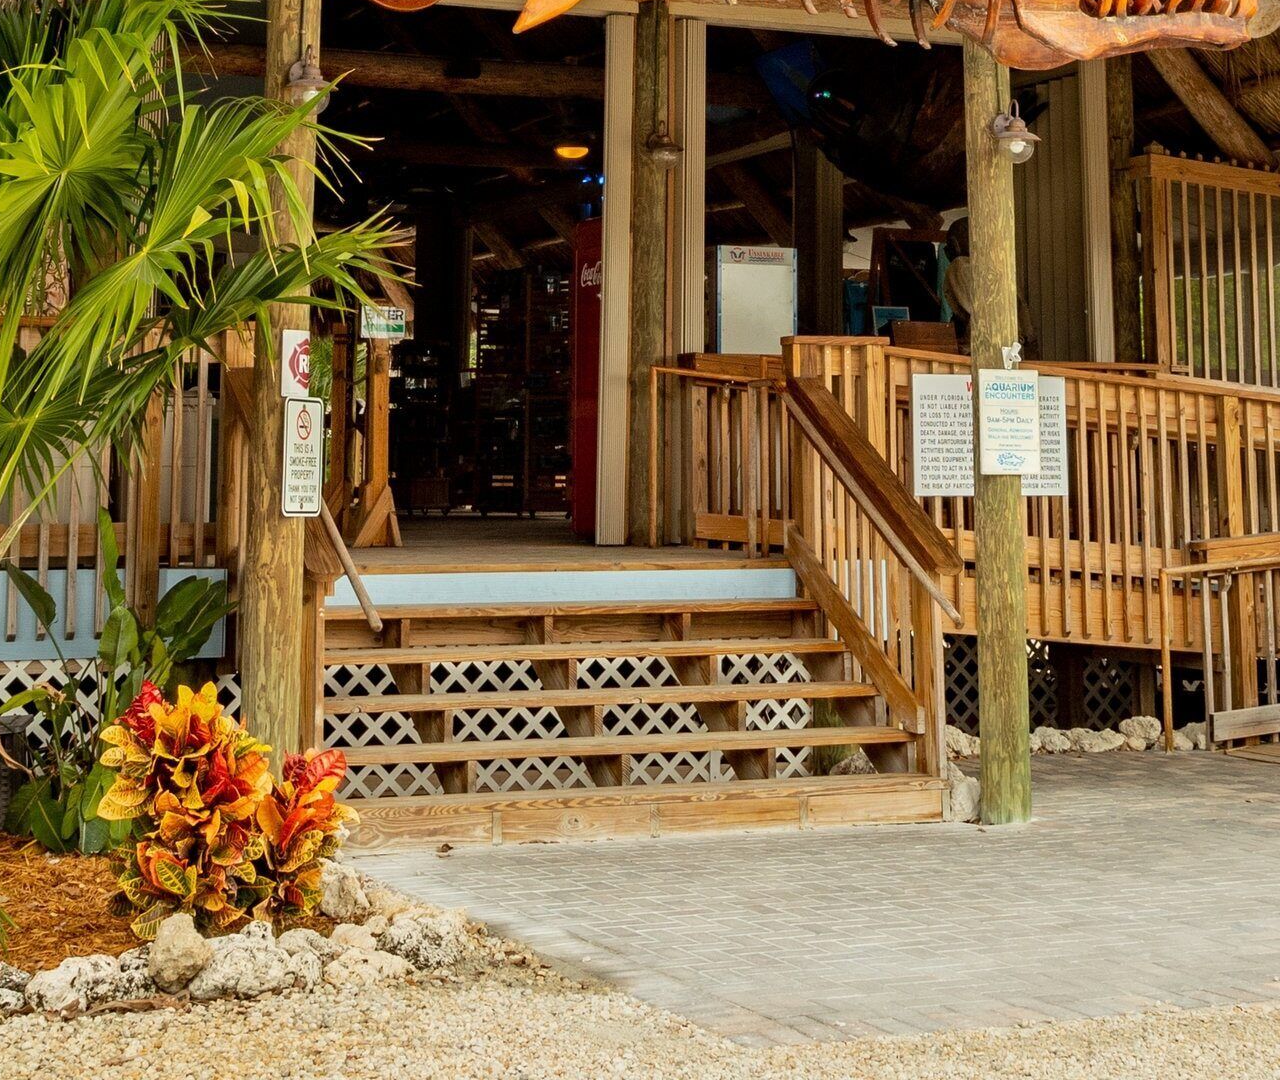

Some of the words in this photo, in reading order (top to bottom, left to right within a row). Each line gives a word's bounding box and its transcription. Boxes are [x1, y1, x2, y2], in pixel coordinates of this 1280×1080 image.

[985, 383, 1034, 391] AQUARIUM
[985, 392, 1034, 400] ENCOUNTERS
[294, 443, 303, 453] THIS
[289, 456, 317, 467] SMOKE-FREE
[291, 469, 314, 480] PROPERTY
